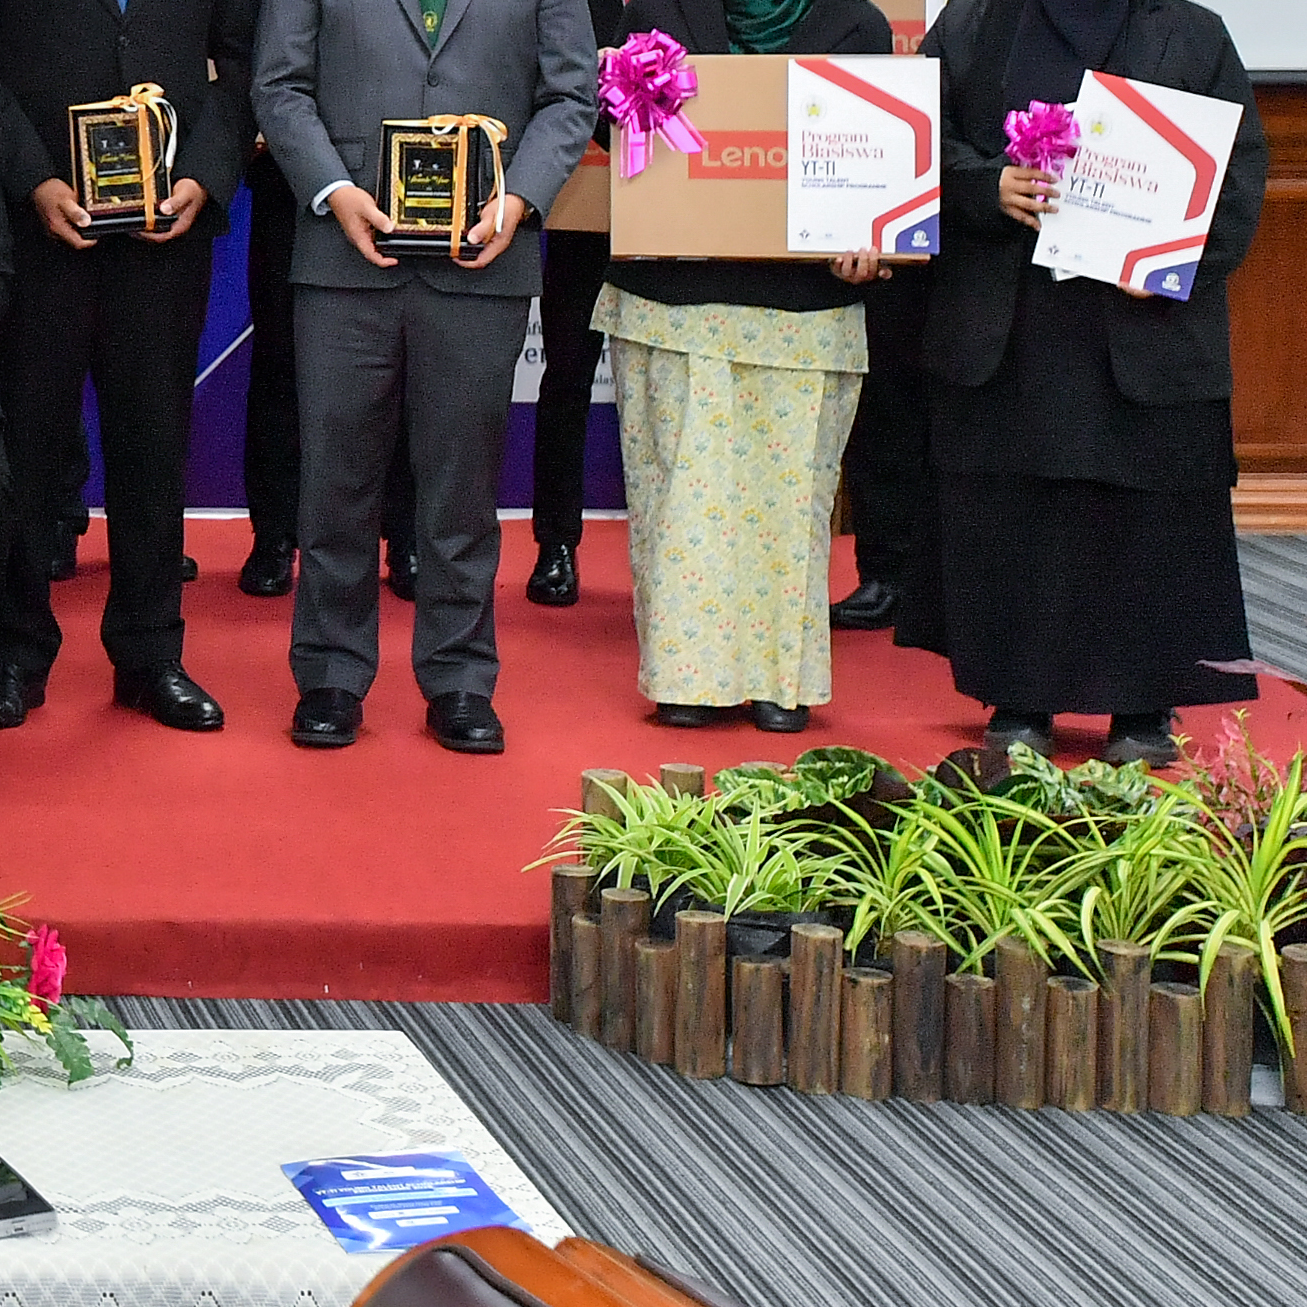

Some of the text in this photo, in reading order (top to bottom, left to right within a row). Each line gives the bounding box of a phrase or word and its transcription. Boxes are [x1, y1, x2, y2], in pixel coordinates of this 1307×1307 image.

[802, 130, 868, 145] Program
[701, 146, 788, 168] Leno
[802, 143, 884, 159] Biasiswa
[1076, 146, 1147, 173] Program
[801, 160, 836, 176] YT-TI
[1073, 158, 1159, 193] Biasiswa
[1069, 176, 1105, 199] YT-TI
